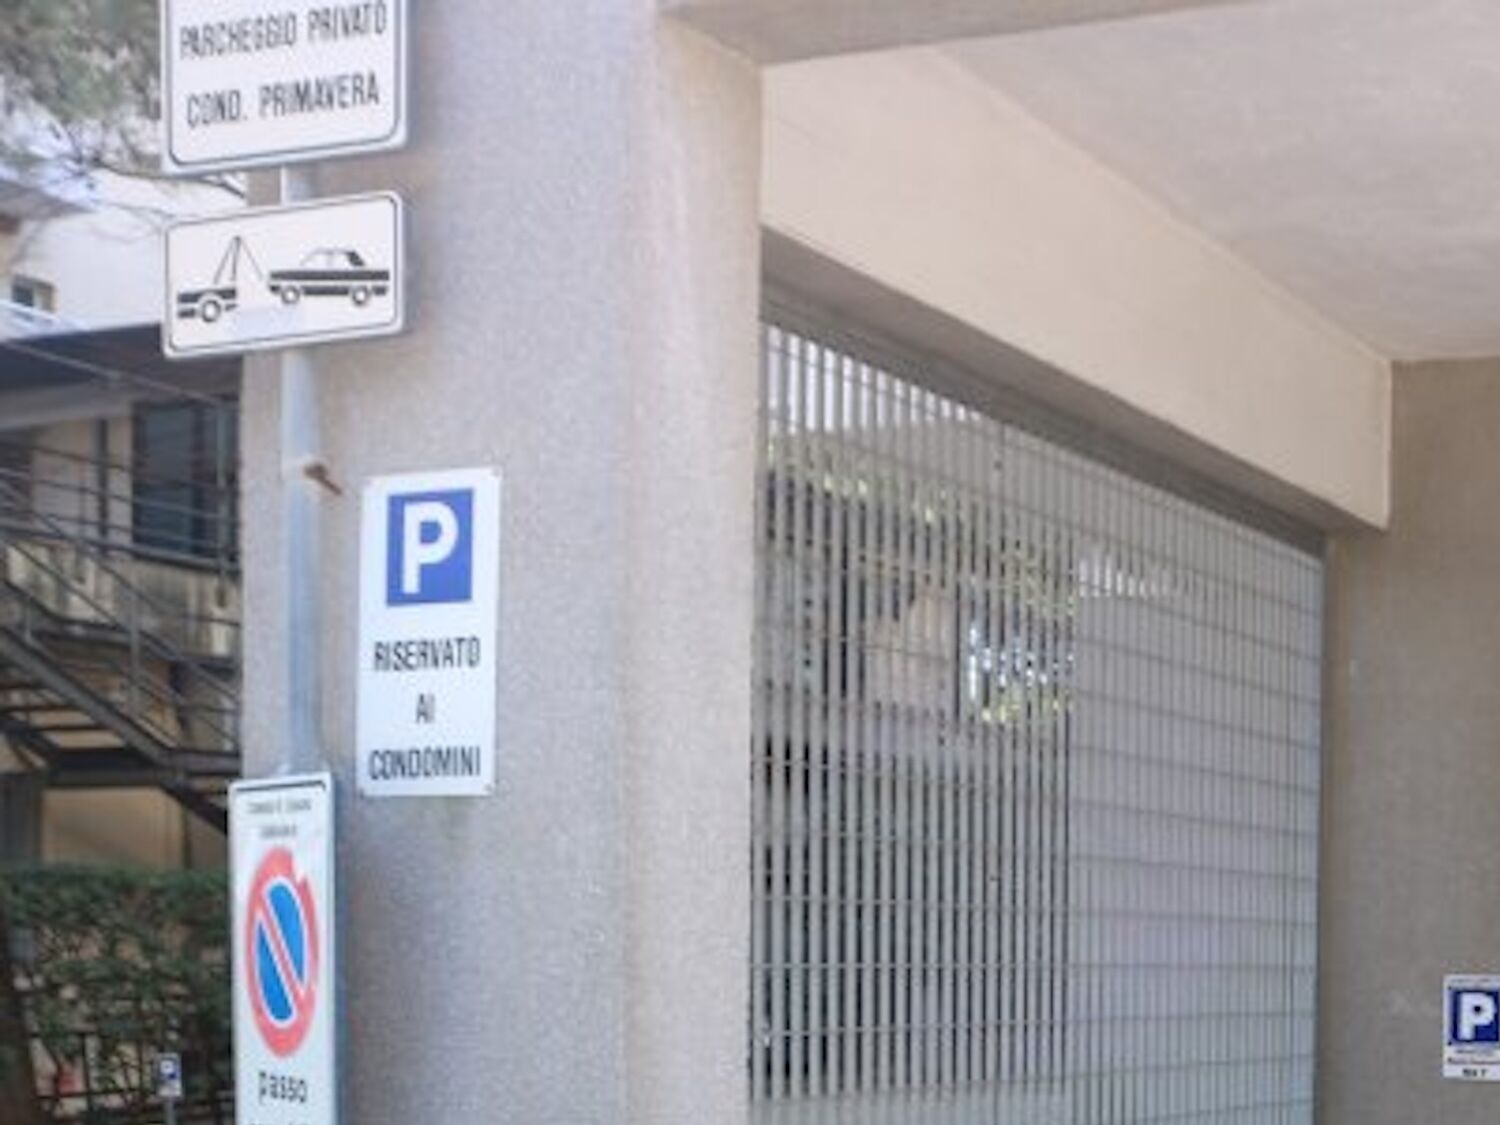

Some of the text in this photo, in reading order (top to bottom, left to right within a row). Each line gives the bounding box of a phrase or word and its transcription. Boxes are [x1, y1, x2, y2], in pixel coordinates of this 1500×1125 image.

[180, 1, 386, 58] PARCHEGGIO PRIVATO
[187, 71, 379, 129] COND. PRIMAVERA
[402, 501, 459, 594] P
[374, 636, 481, 671] RISERVATO
[416, 693, 435, 723] AI
[369, 746, 481, 779] CONDOMINI
[1461, 992, 1496, 1040] P
[258, 1070, 308, 1105] passo
